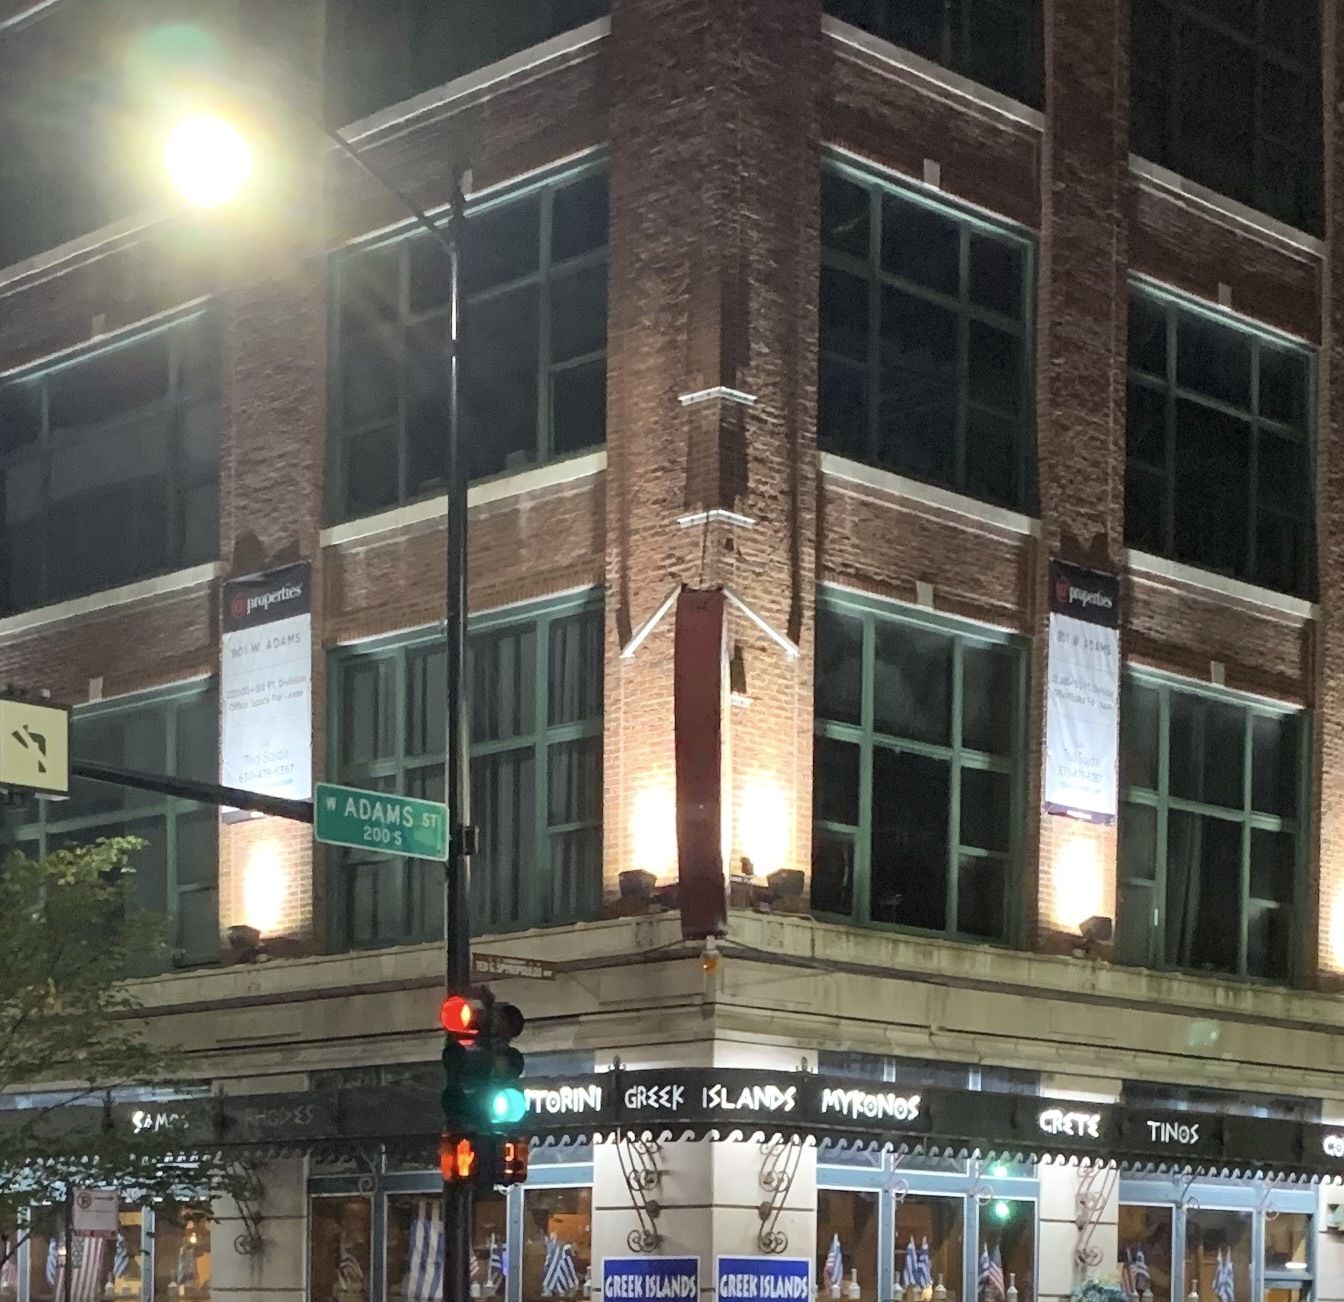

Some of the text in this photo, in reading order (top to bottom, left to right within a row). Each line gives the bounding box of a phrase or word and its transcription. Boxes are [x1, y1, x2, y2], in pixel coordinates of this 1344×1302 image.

[326, 797, 438, 828] W ADAMS ST
[363, 825, 390, 843] 200
[624, 1083, 797, 1112] GREEK ISLANDS
[821, 1088, 921, 1120] MYKONOS
[244, 1104, 315, 1127] RHODES
[1039, 1109, 1102, 1138] CRETE
[1146, 1120, 1200, 1145] TINOS
[605, 1273, 696, 1299] GREEK ISLANDS
[719, 1274, 807, 1299] GREEK ISLANDS
